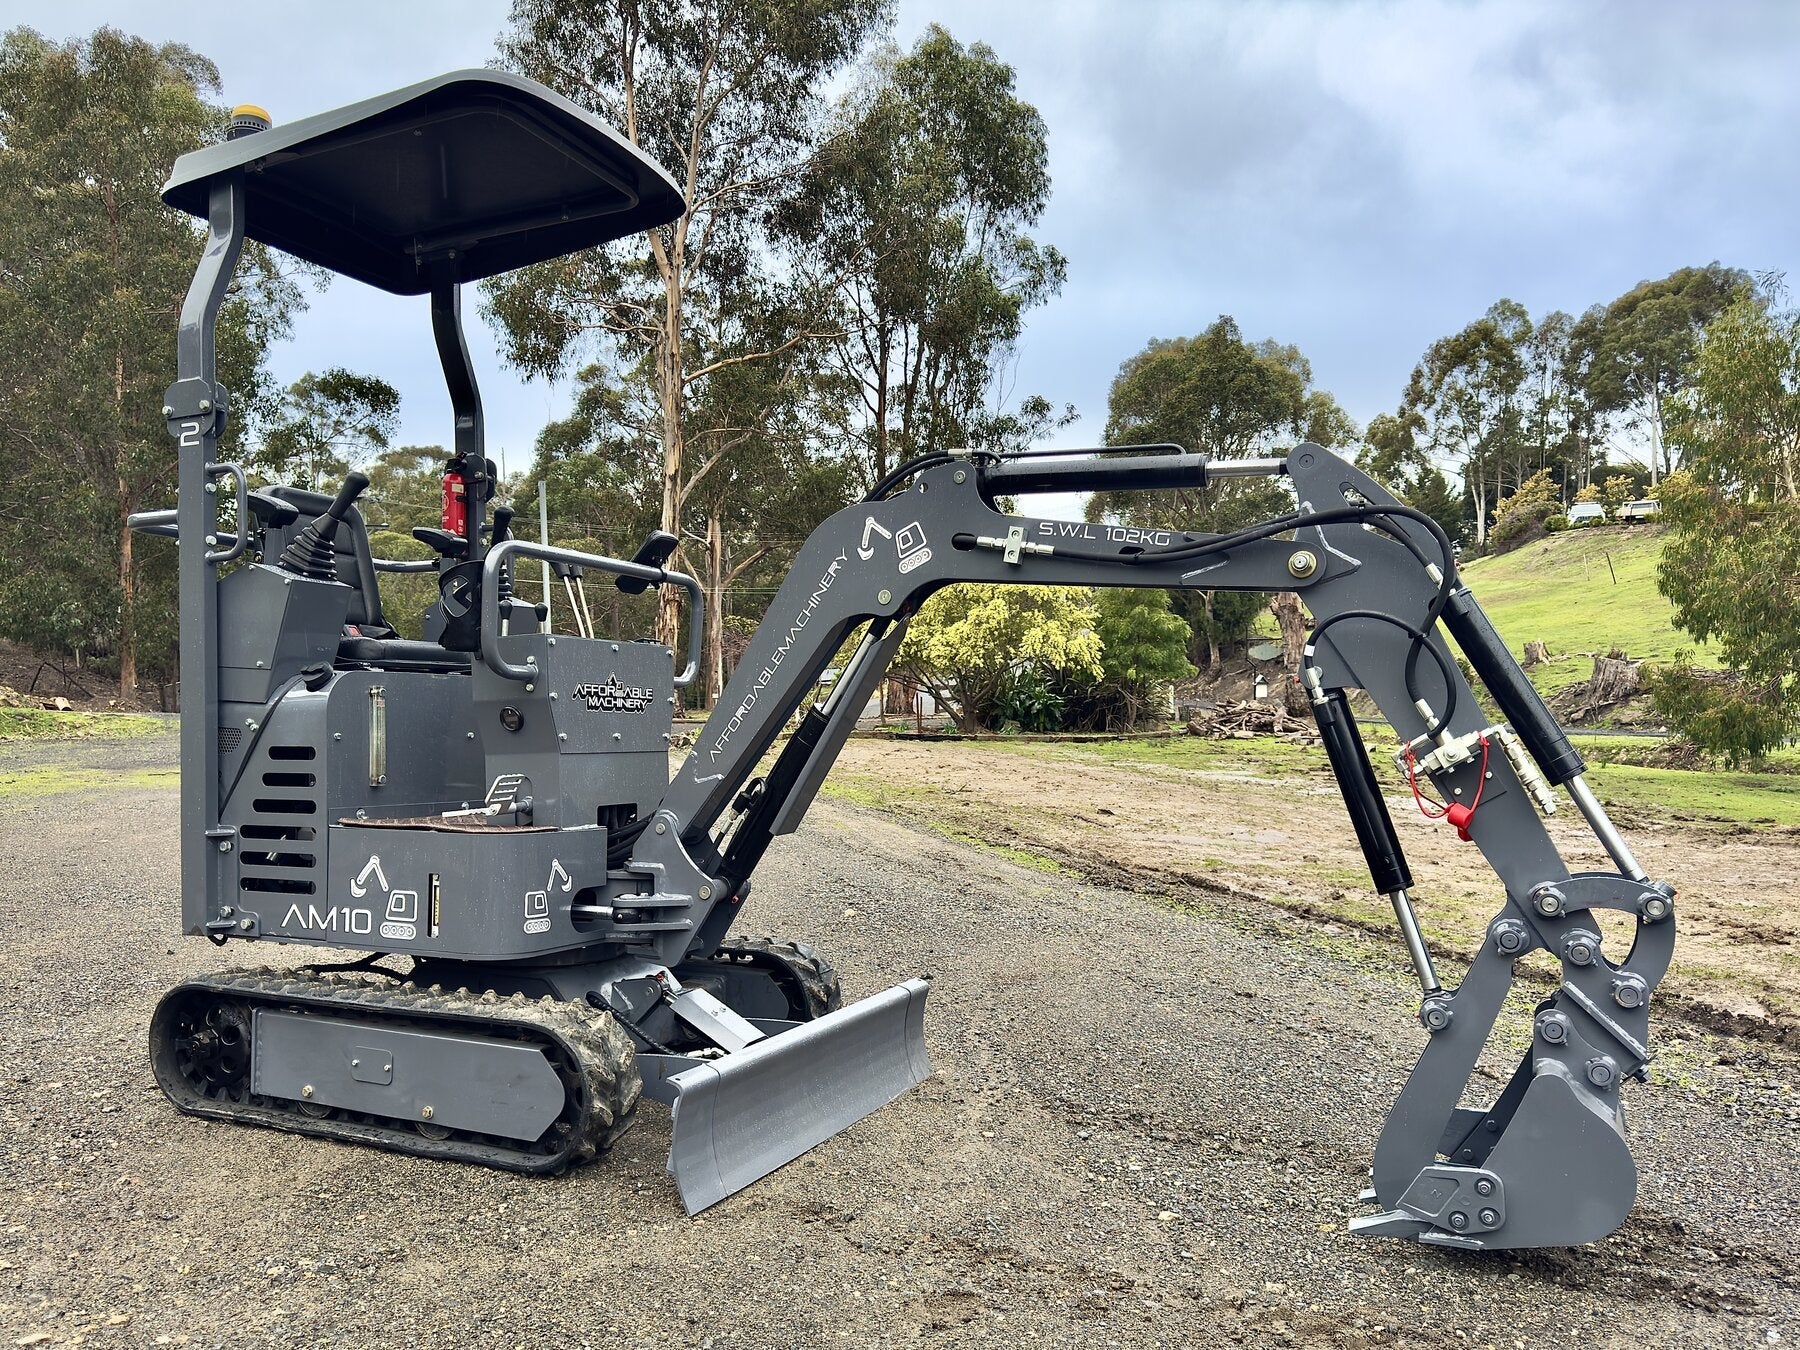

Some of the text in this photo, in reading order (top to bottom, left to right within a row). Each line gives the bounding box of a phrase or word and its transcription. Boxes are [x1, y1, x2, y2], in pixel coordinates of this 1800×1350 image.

[180, 421, 200, 447] 2
[1038, 522, 1171, 546] S.W.L 102KG
[709, 547, 847, 764] AFFORDABLEMACHINERY
[574, 683, 653, 699] AFFORABLE
[588, 696, 648, 709] MACHINERY
[280, 903, 372, 934] AM10
